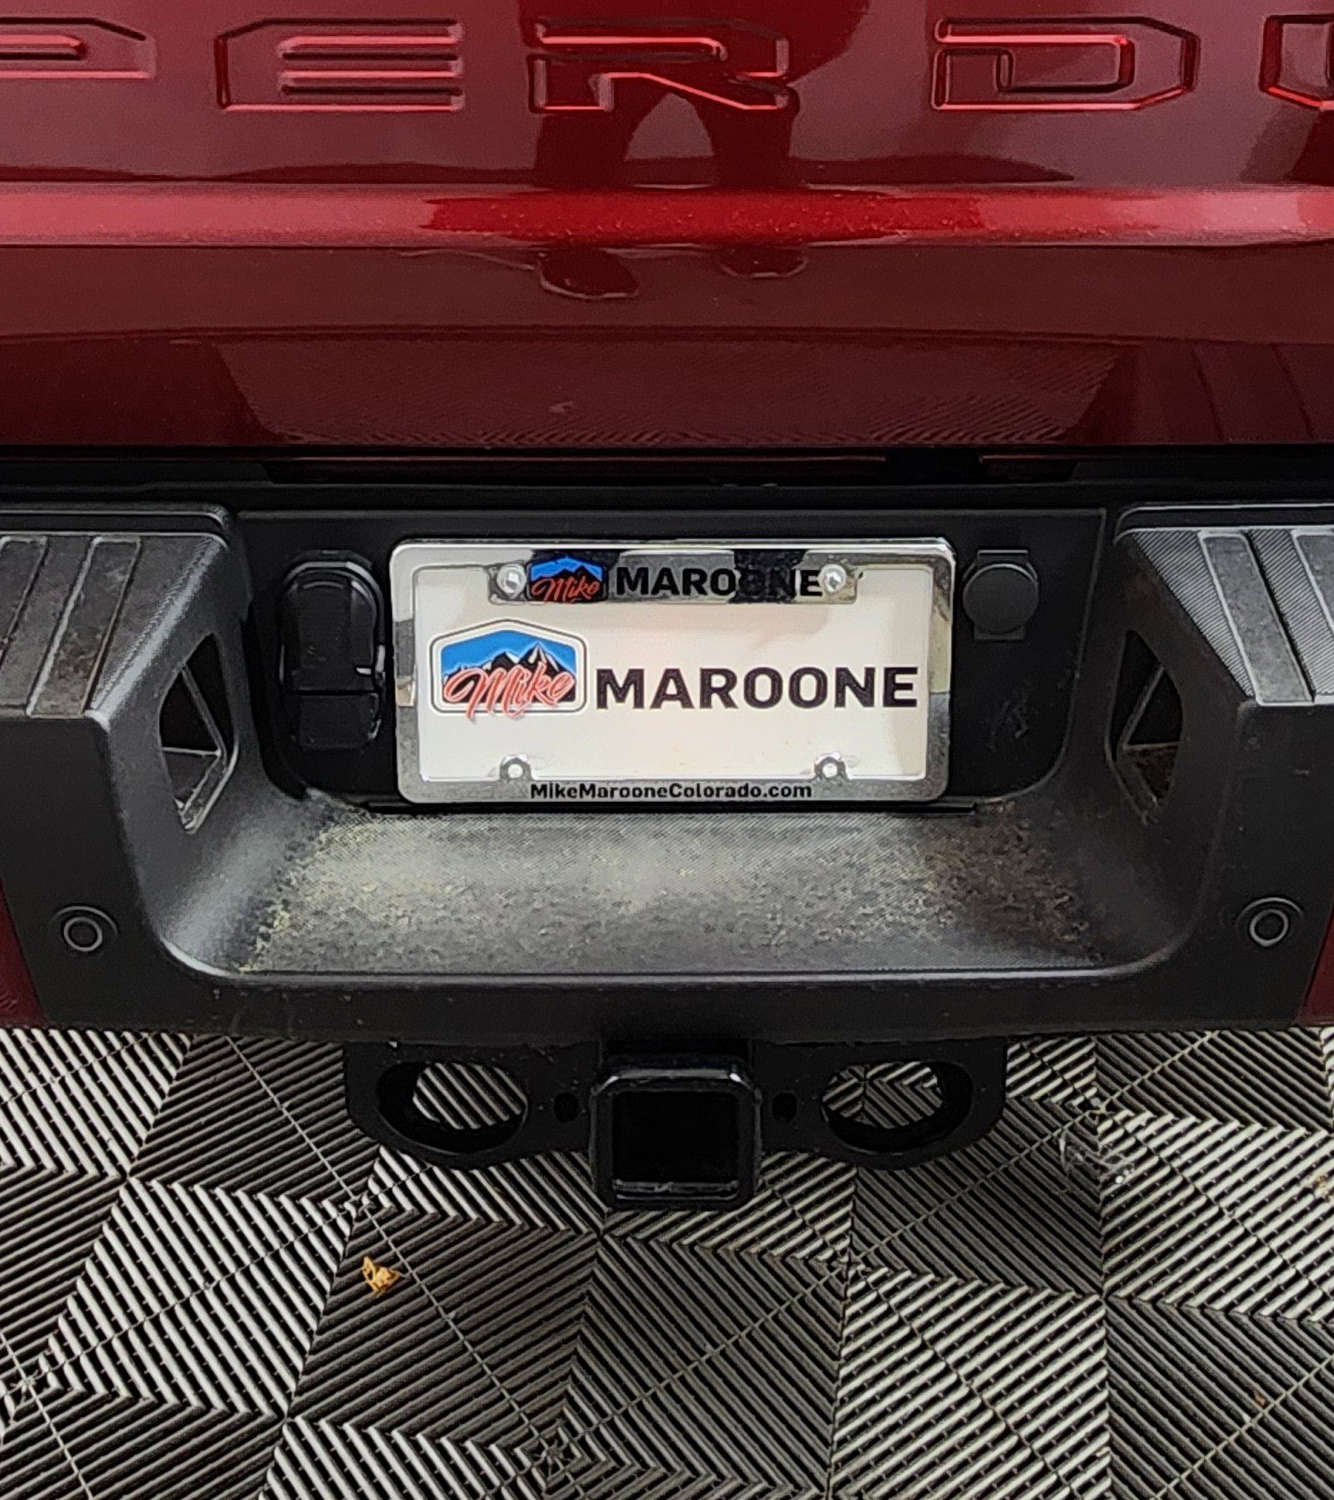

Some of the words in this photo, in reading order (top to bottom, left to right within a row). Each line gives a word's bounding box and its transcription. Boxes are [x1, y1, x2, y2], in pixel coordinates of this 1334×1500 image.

[531, 578, 600, 602] Mike
[616, 566, 824, 596] MAROONE
[444, 661, 577, 720] Mike
[596, 667, 920, 710] MAROONE
[531, 782, 812, 799] MikeMarooneColorado.com
